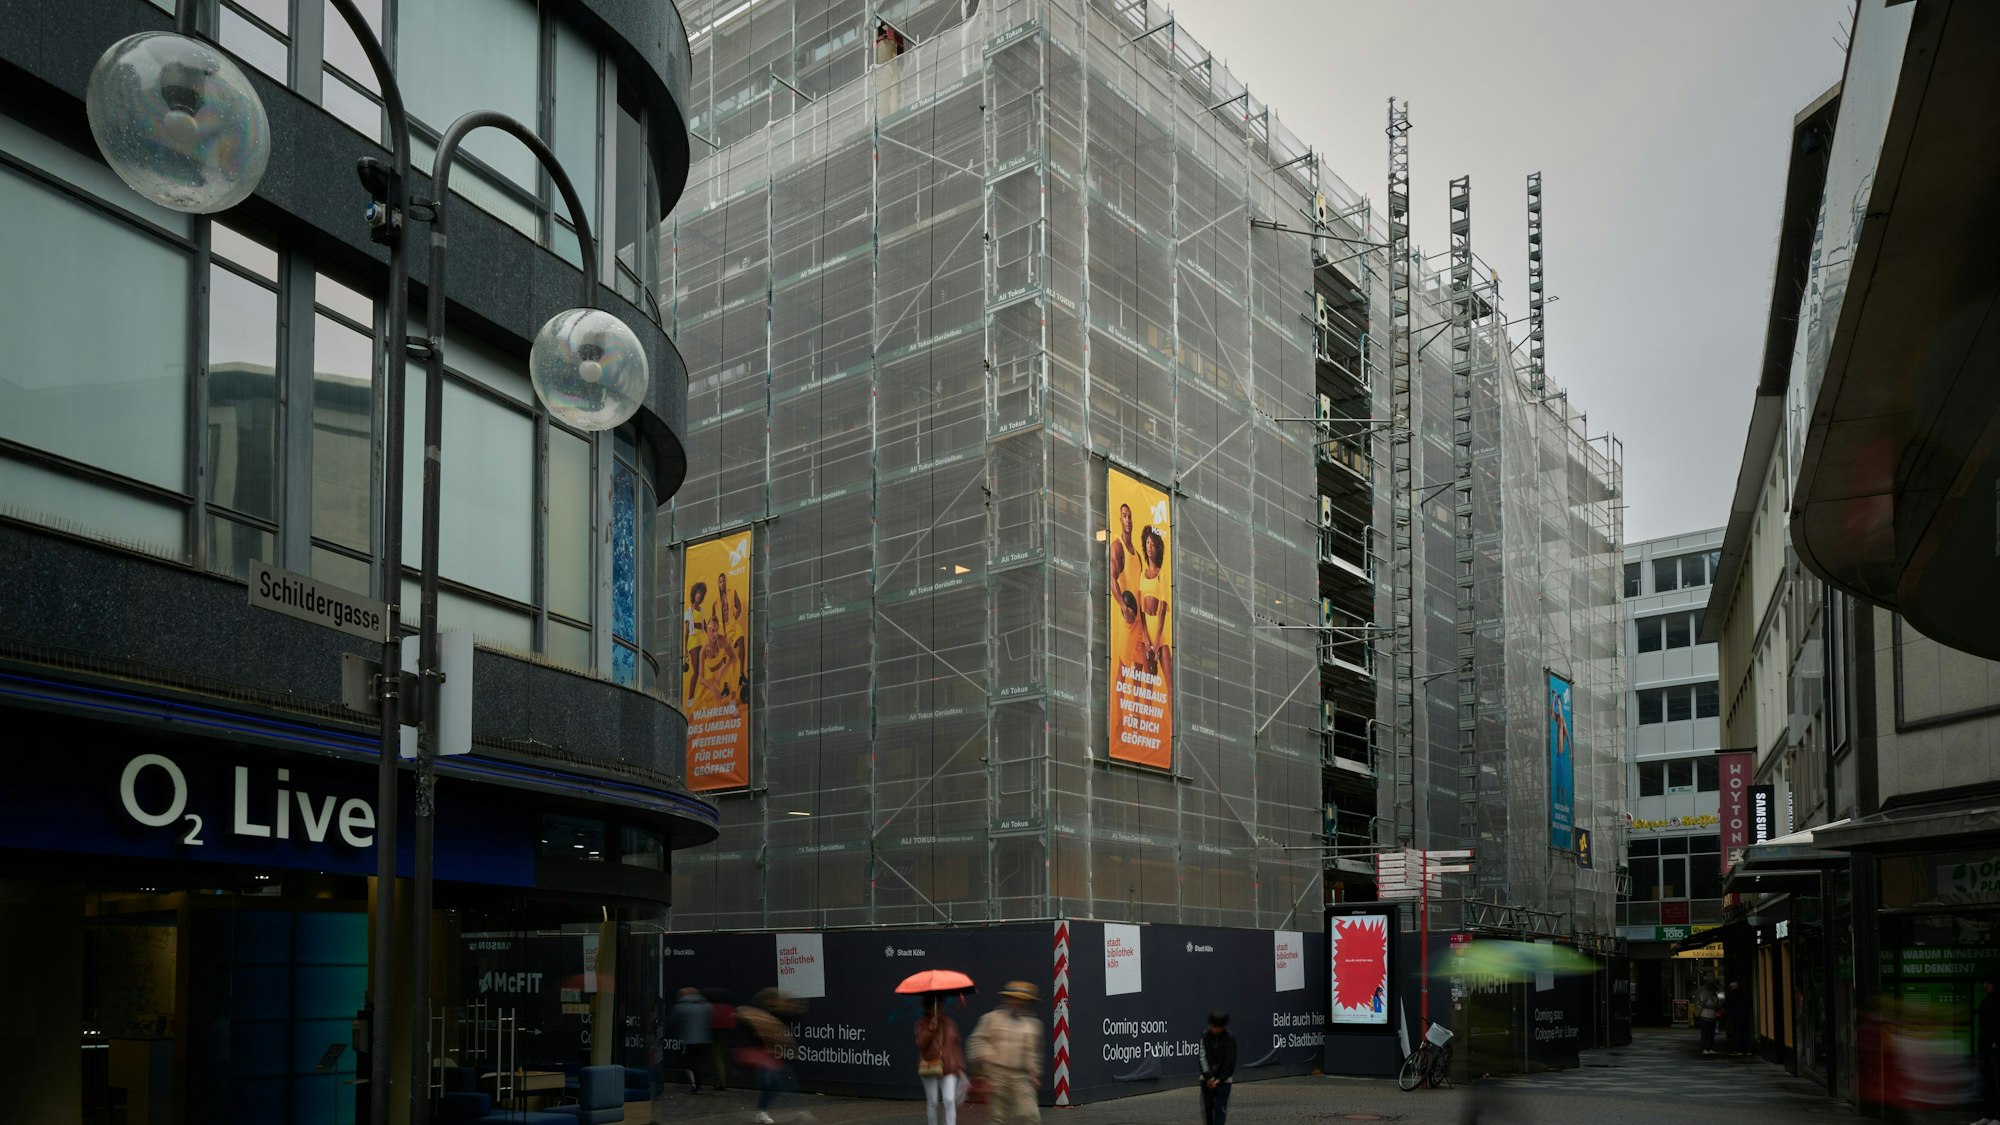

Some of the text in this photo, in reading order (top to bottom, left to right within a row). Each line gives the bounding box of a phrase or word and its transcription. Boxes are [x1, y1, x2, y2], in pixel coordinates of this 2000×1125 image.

[996, 28, 1022, 44] Ali Tokus
[1008, 157, 1026, 168] Tokus
[1008, 288, 1026, 298] Tokus
[1057, 294, 1075, 308] TOKUS
[918, 339, 932, 348] Tokus
[1009, 420, 1026, 429] Tokus
[1011, 552, 1028, 561] Tokus
[728, 566, 746, 576] McFIT
[260, 571, 379, 630] Schildergasse
[1121, 662, 1162, 686] WÄHREND
[1010, 686, 1028, 694] Tokus
[1061, 692, 1074, 700] Tokus
[1116, 680, 1168, 704] DES UMBAUS
[692, 704, 736, 720] WÄHREND
[1120, 698, 1164, 718] WEITERHIN
[688, 718, 741, 736] DES UMBAUS
[1122, 713, 1160, 734] FÜR DICH
[692, 733, 737, 749] WEITERHIN
[1120, 731, 1161, 750] GEÖFFNET
[695, 748, 734, 762] FÜR DICH
[694, 761, 736, 776] GEÖFFNET
[234, 766, 376, 848] Live
[1730, 764, 1742, 842] WOYTON
[1011, 820, 1028, 828] Tokus
[1062, 826, 1074, 834] Tokus
[914, 836, 936, 844] TOKUS
[1662, 930, 1684, 938] TOTO
[1107, 938, 1120, 946] stadt
[780, 947, 797, 956] stadt
[1107, 948, 1134, 958] bibliothek
[1276, 952, 1298, 960] bibliothek
[1903, 950, 1940, 959] WARUM
[780, 956, 814, 965] bibliothek
[1108, 960, 1119, 968] köln
[780, 966, 795, 975] köln
[1903, 962, 1975, 974] NEU DENKEN?
[494, 971, 543, 993] McFIT
[1273, 1012, 1290, 1027] Bald
[1293, 1011, 1310, 1026] auch
[1534, 1008, 1553, 1023] Coming
[804, 1024, 834, 1040] auch
[838, 1025, 866, 1041] hier:
[1102, 1018, 1168, 1038] Coming soon:
[1534, 1027, 1554, 1043] Cologne
[1273, 1034, 1286, 1048] Die
[774, 1044, 890, 1067] Die Stadtbibliothek
[1102, 1044, 1141, 1063] Cologne
[1144, 1042, 1174, 1058] Public
